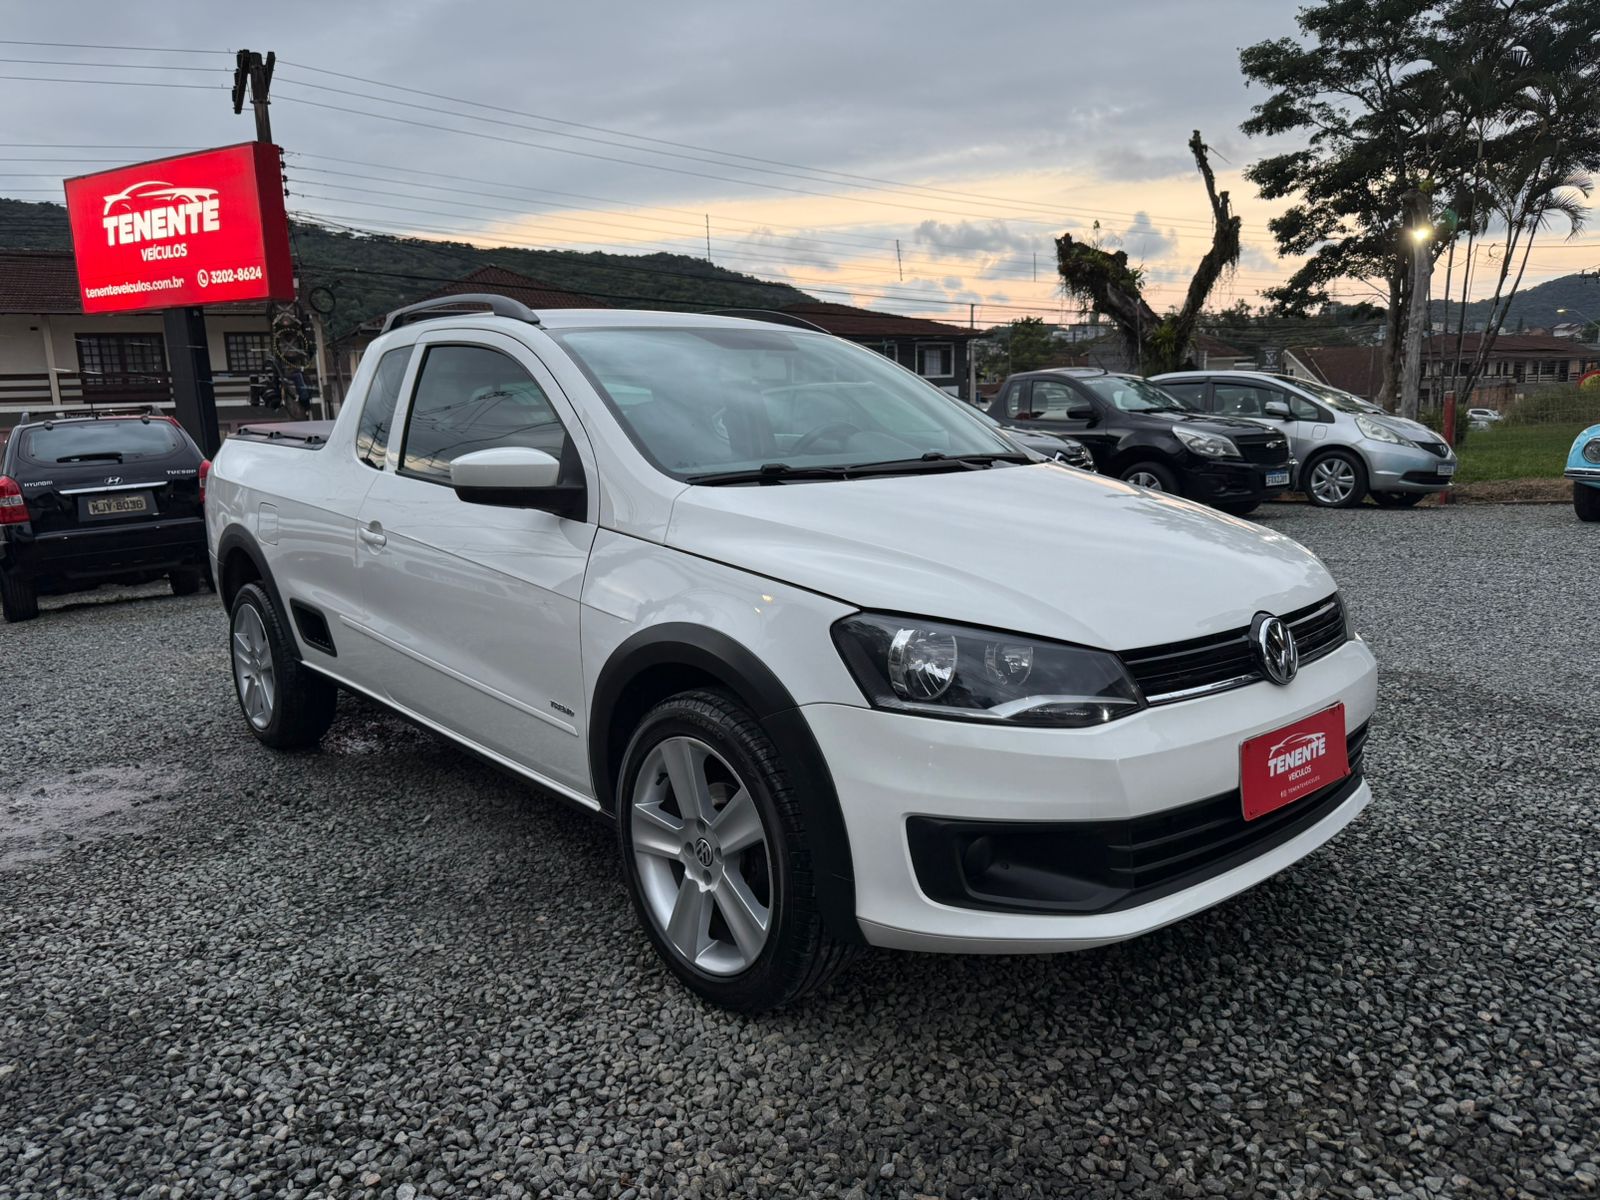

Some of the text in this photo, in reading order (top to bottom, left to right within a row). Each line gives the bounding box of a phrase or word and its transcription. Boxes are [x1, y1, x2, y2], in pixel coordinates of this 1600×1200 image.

[103, 199, 220, 246] TENENTE
[141, 243, 188, 262] VEÍCULOS
[210, 266, 263, 284] 3202-8624
[85, 276, 184, 298] tenenteveiculos.com.br
[1267, 737, 1326, 777] TENENTE
